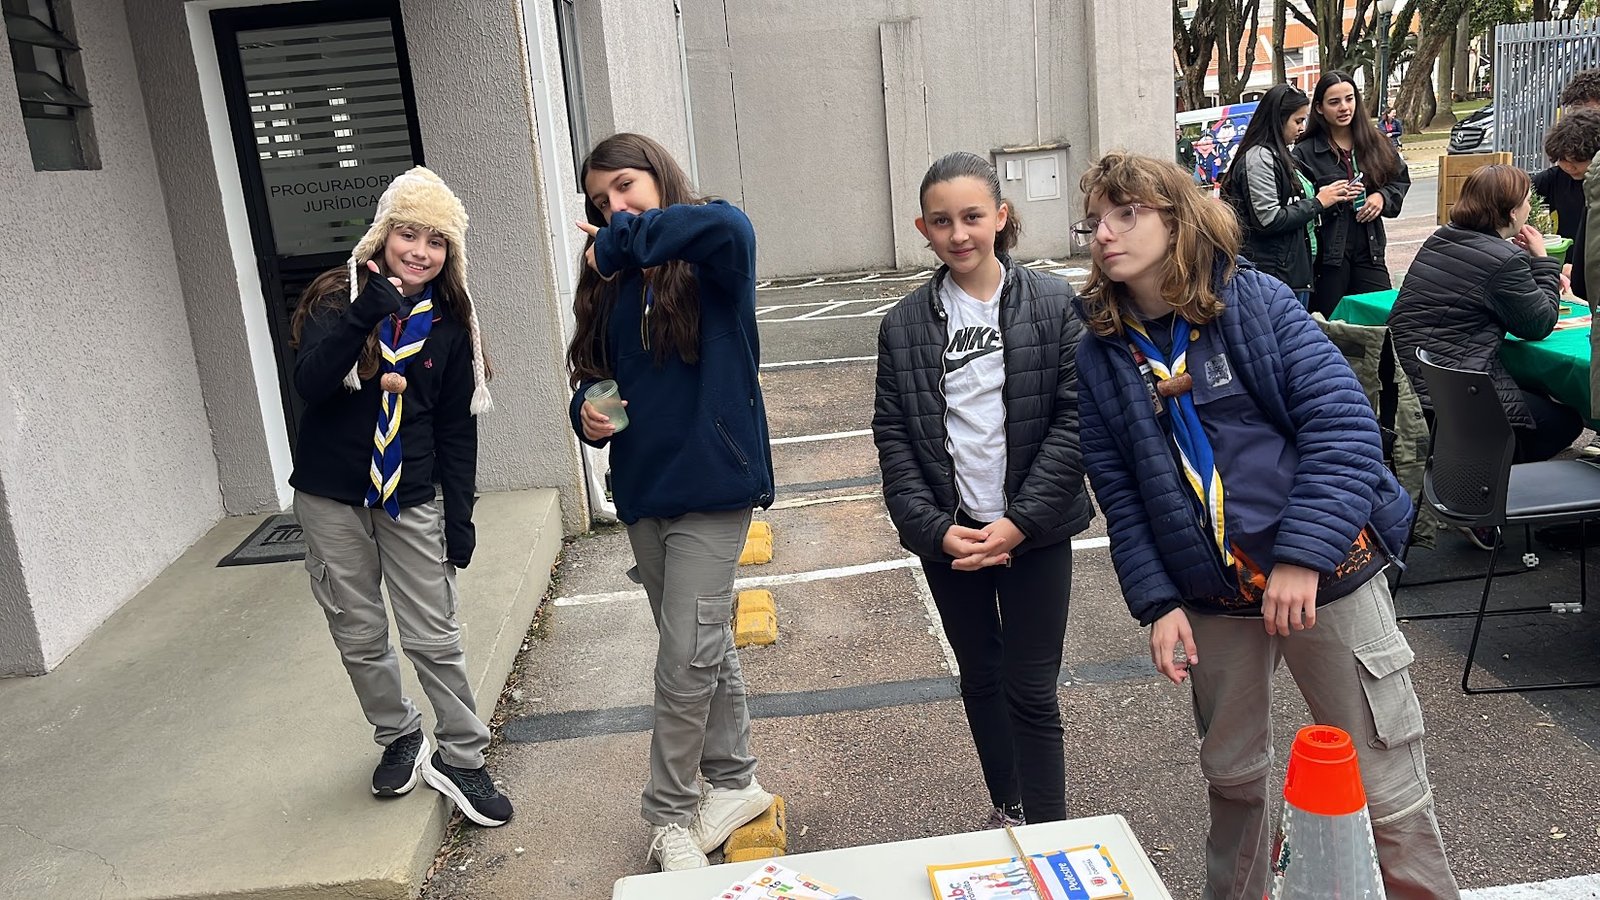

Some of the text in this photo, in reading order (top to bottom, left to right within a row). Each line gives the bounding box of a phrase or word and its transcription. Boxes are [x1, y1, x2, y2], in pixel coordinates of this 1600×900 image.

[303, 194, 380, 213] JURÍDICA
[947, 326, 1002, 353] NIKE
[1058, 862, 1082, 891] Pedestre
